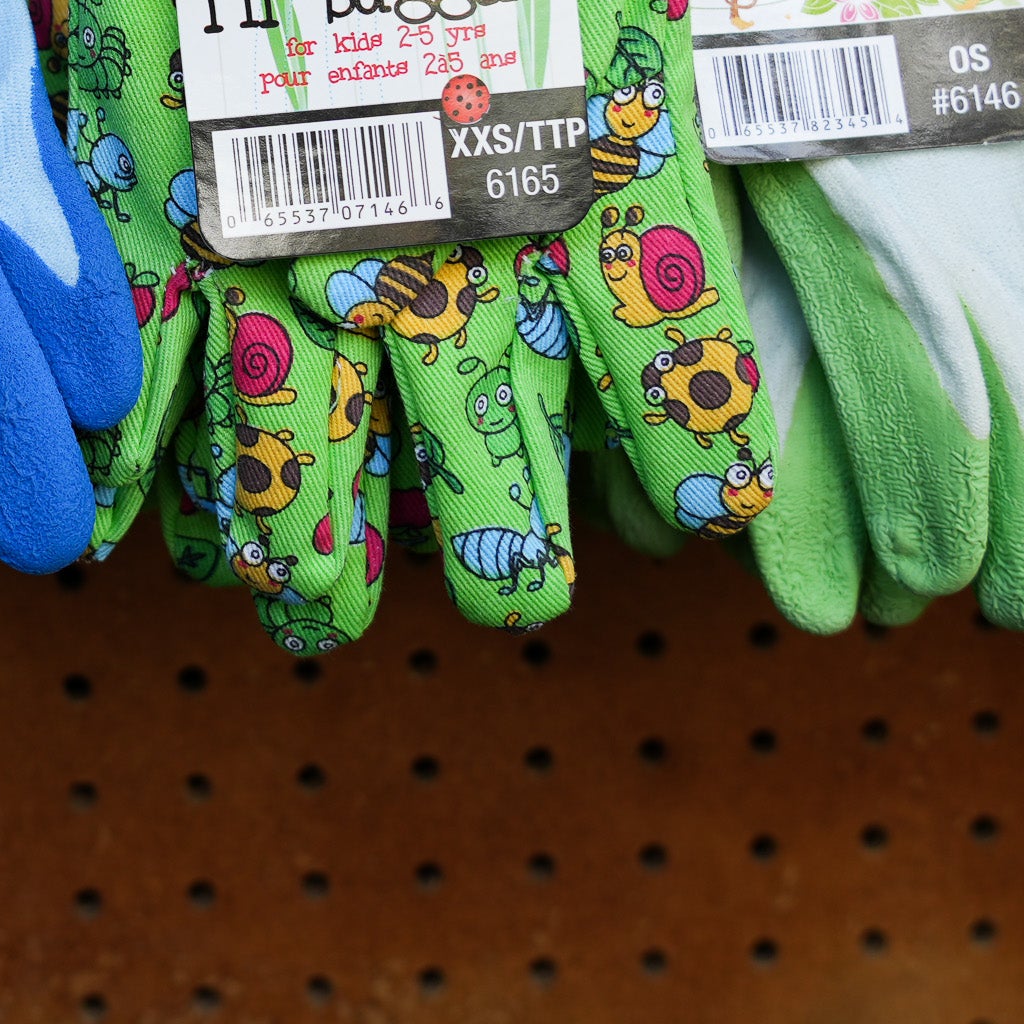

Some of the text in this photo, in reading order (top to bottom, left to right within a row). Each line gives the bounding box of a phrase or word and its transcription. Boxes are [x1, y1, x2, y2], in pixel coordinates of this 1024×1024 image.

[287, 24, 486, 58] for kids 2-5 yrs
[259, 71, 311, 94] pour
[328, 60, 408, 84] enfants
[480, 50, 517, 70] ans
[948, 44, 991, 74] OS
[932, 81, 1021, 116] #6146
[449, 118, 587, 159] XXS/TTP
[743, 121, 799, 136] 65537
[811, 116, 868, 132] 82345
[486, 164, 560, 200] 6165
[264, 208, 329, 227] 65537
[343, 200, 408, 220] 07146
